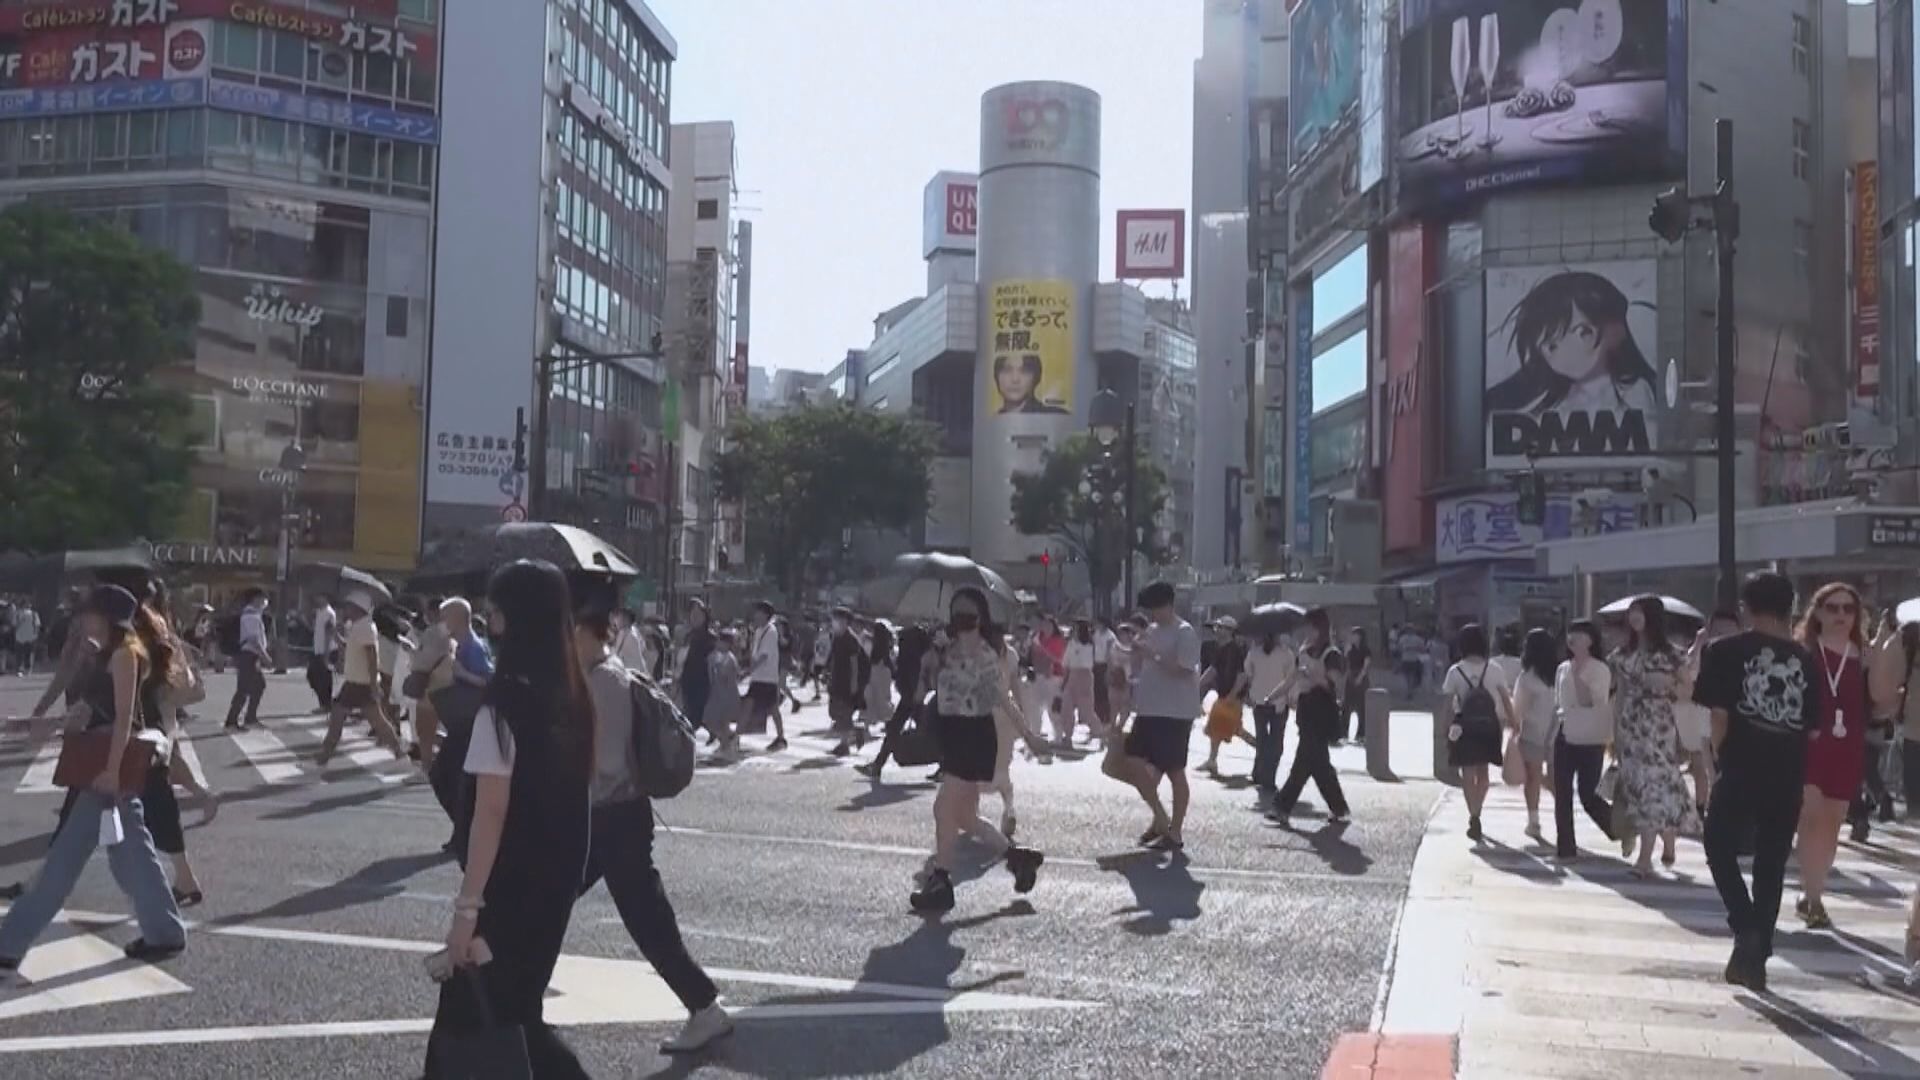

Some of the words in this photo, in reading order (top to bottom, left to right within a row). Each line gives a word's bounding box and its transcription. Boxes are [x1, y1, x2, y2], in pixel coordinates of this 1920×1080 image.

[340, 21, 417, 58] ガスト
[71, 41, 156, 82] ガスト
[996, 309, 1068, 330] できるって、
[1492, 409, 1650, 456] DMM
